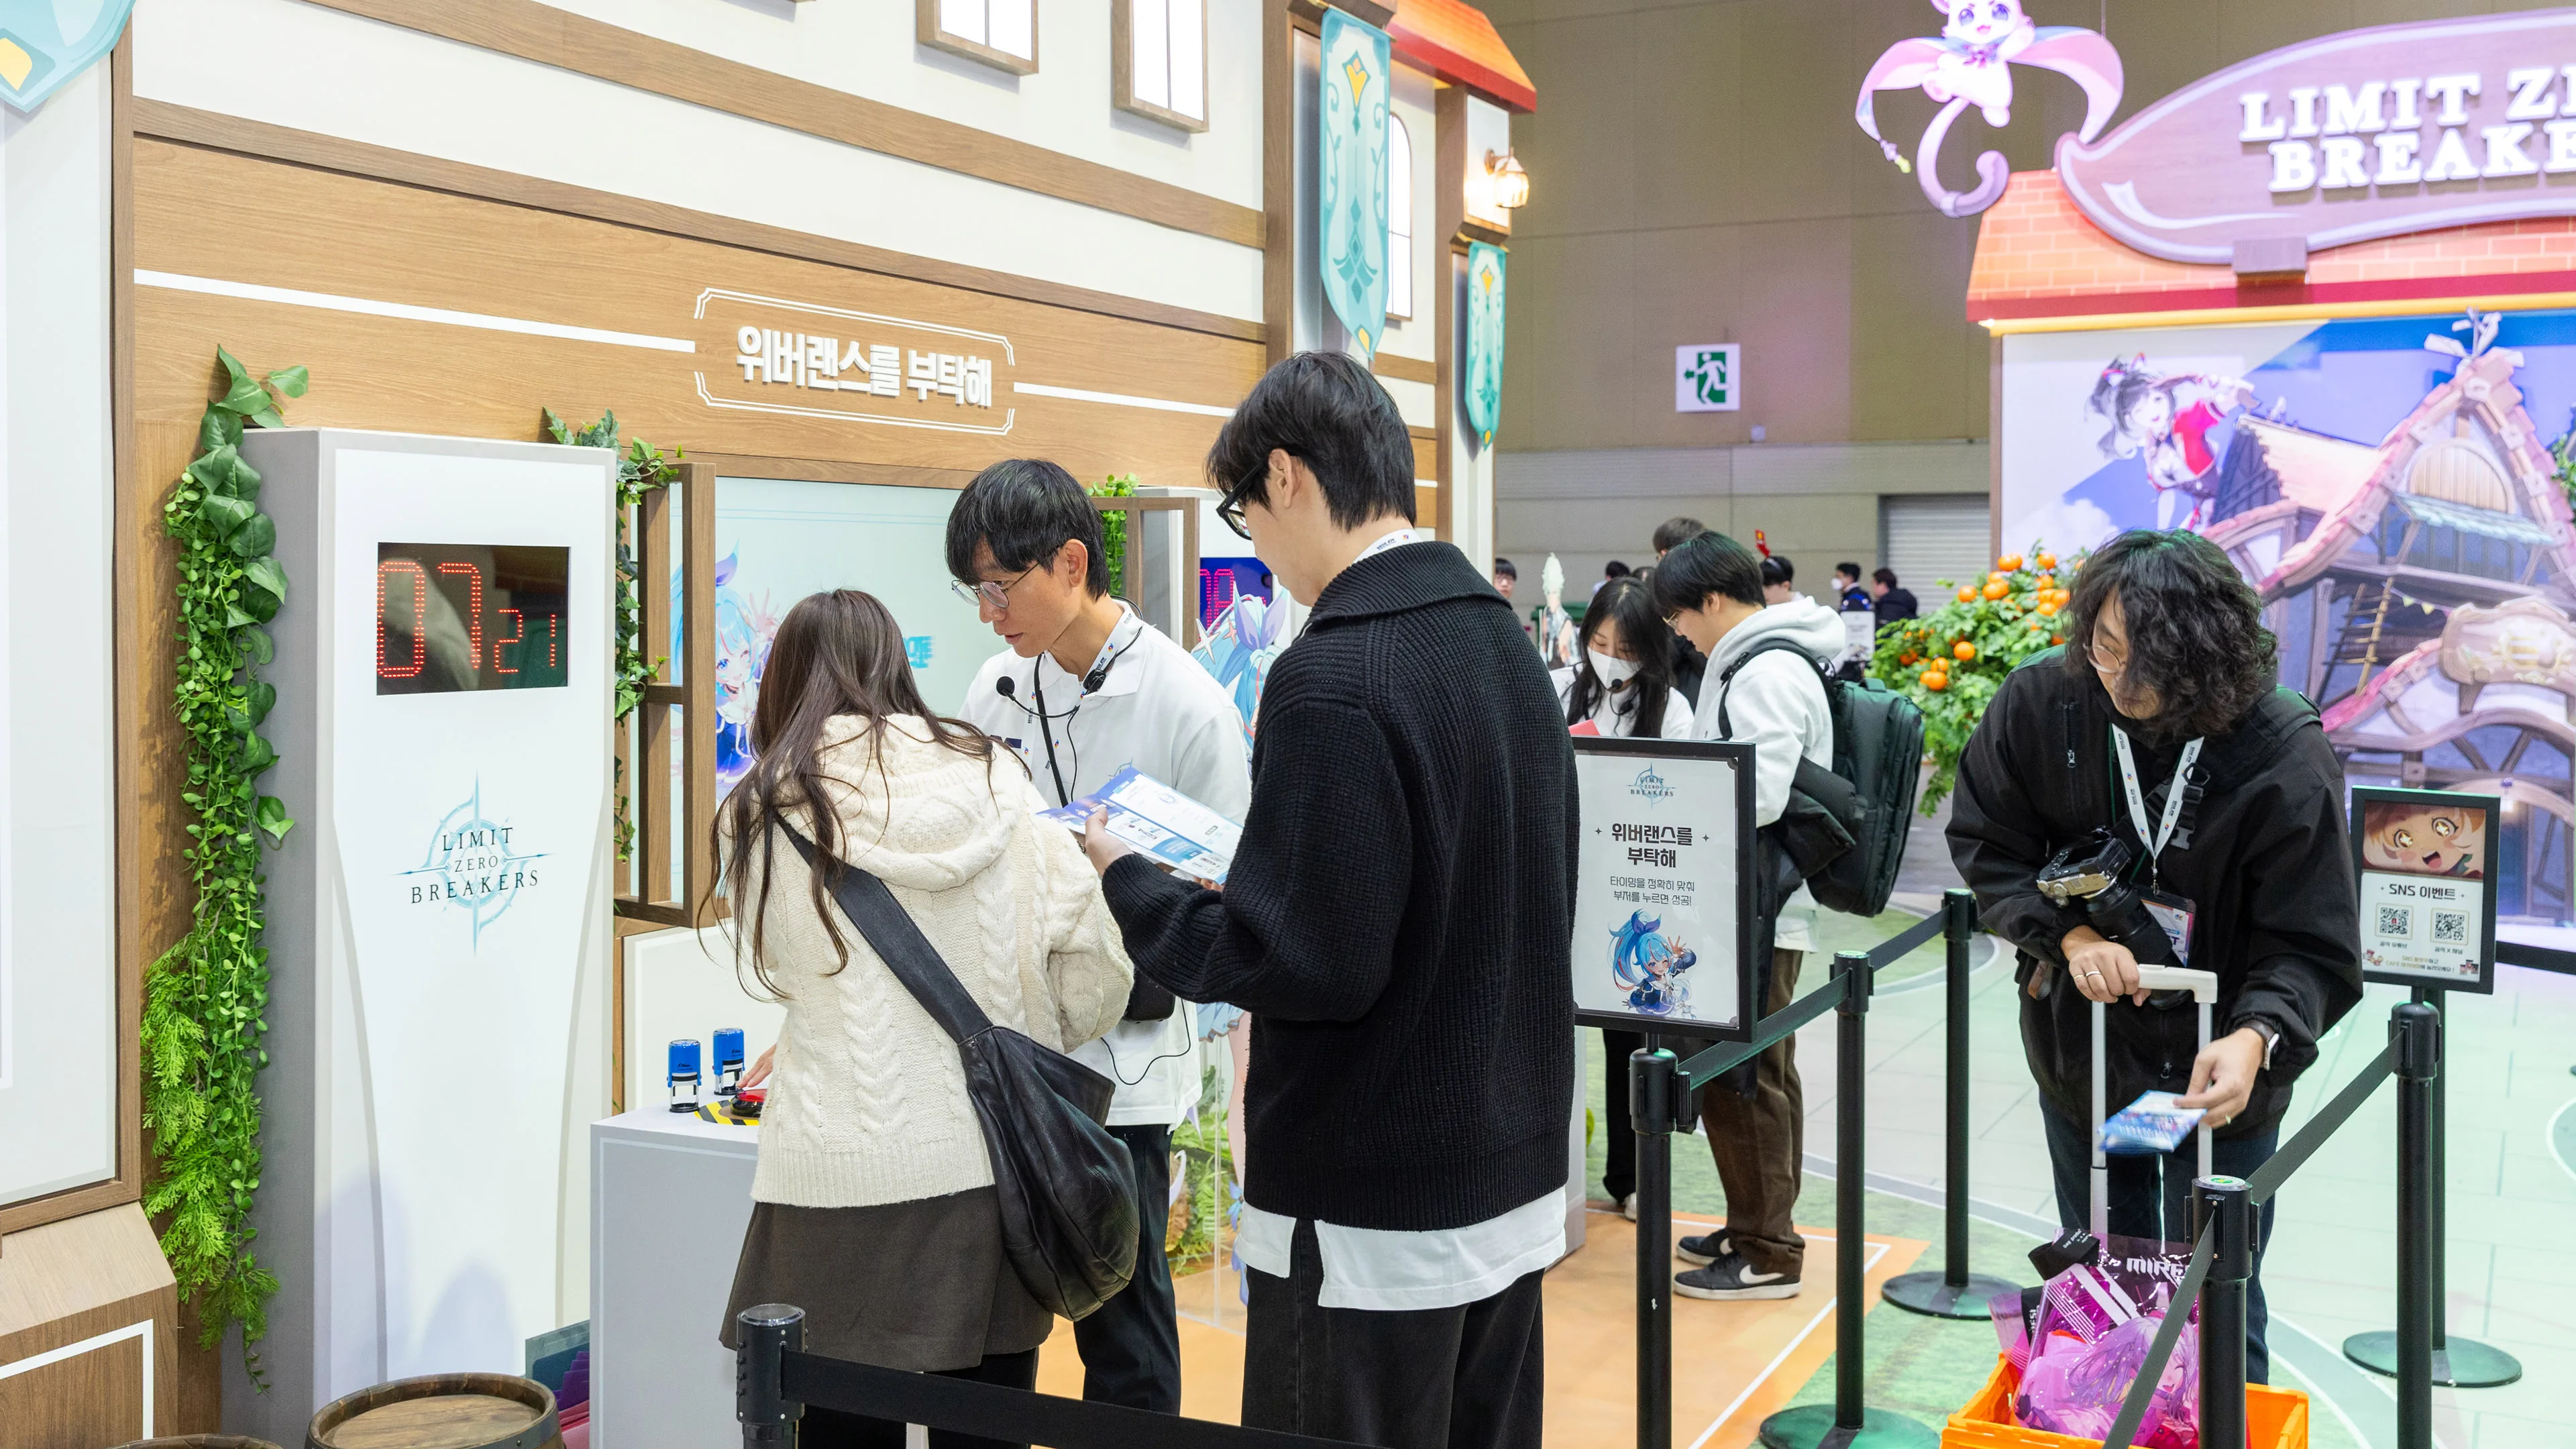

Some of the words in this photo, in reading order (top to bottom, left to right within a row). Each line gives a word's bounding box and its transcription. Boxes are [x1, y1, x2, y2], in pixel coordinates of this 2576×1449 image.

[2239, 73, 2481, 142] LIMIT
[2268, 119, 2576, 192] BREAKE
[737, 326, 900, 397] 위버랜스를
[907, 350, 991, 407] 부탁해
[442, 827, 513, 851] LIMIT
[1612, 822, 1693, 846] 위버랜스를
[455, 855, 498, 873] ZERO
[1627, 847, 1676, 868] 부탁해
[411, 869, 538, 904] BREAKERS
[1610, 876, 1646, 889] 타이밍을
[1648, 878, 1674, 891] 정확히
[1677, 881, 1695, 892] 맞춰
[2389, 883, 2416, 896] SNS
[2420, 885, 2456, 900] 이벤트
[1614, 890, 1640, 902] 부저를
[1642, 892, 1669, 904] 누르면
[1672, 895, 1692, 906] 성공!
[2126, 1253, 2190, 1289] MIRE
